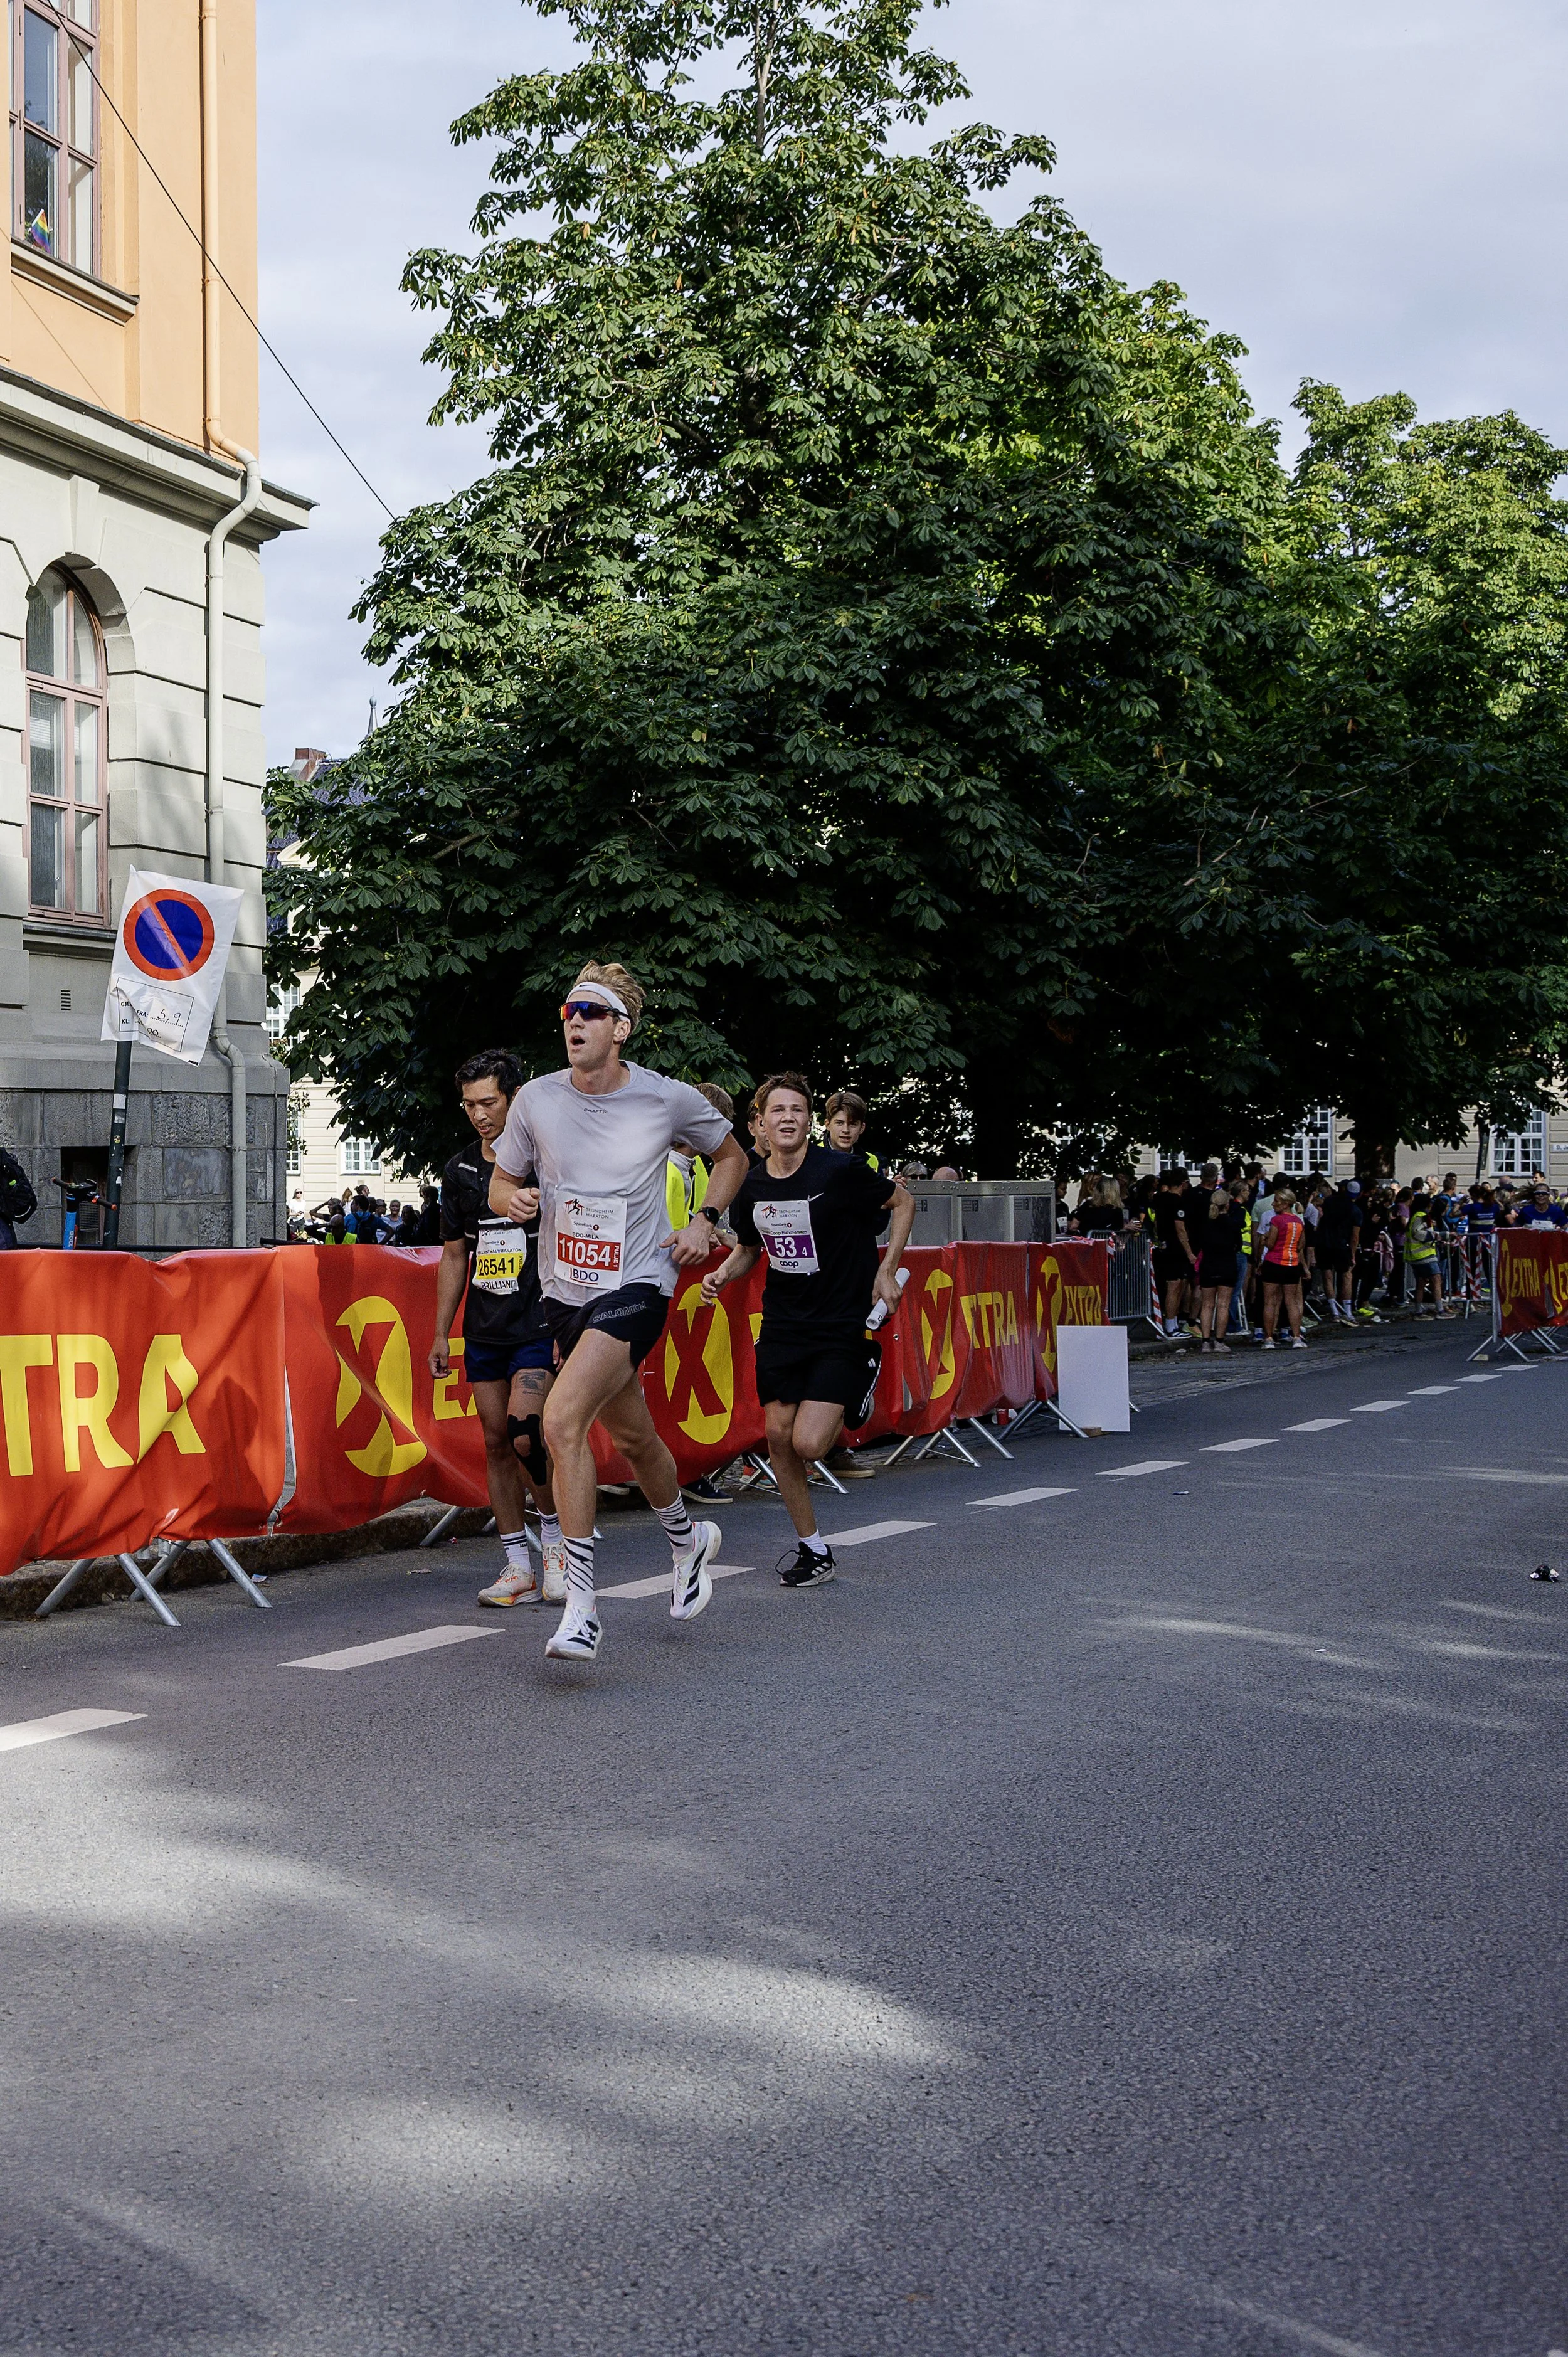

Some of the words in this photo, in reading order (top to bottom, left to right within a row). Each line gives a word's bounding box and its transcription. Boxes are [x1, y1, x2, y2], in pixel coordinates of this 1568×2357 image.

[559, 1237, 611, 1266] 11054
[774, 1237, 797, 1258] 53
[802, 1247, 808, 1256] 4
[479, 1257, 514, 1276] 26541
[573, 1269, 599, 1282] BDO
[1511, 1258, 1541, 1298] EXTRA
[593, 1301, 647, 1323] SALOMON
[0, 1333, 206, 1477] TRA
